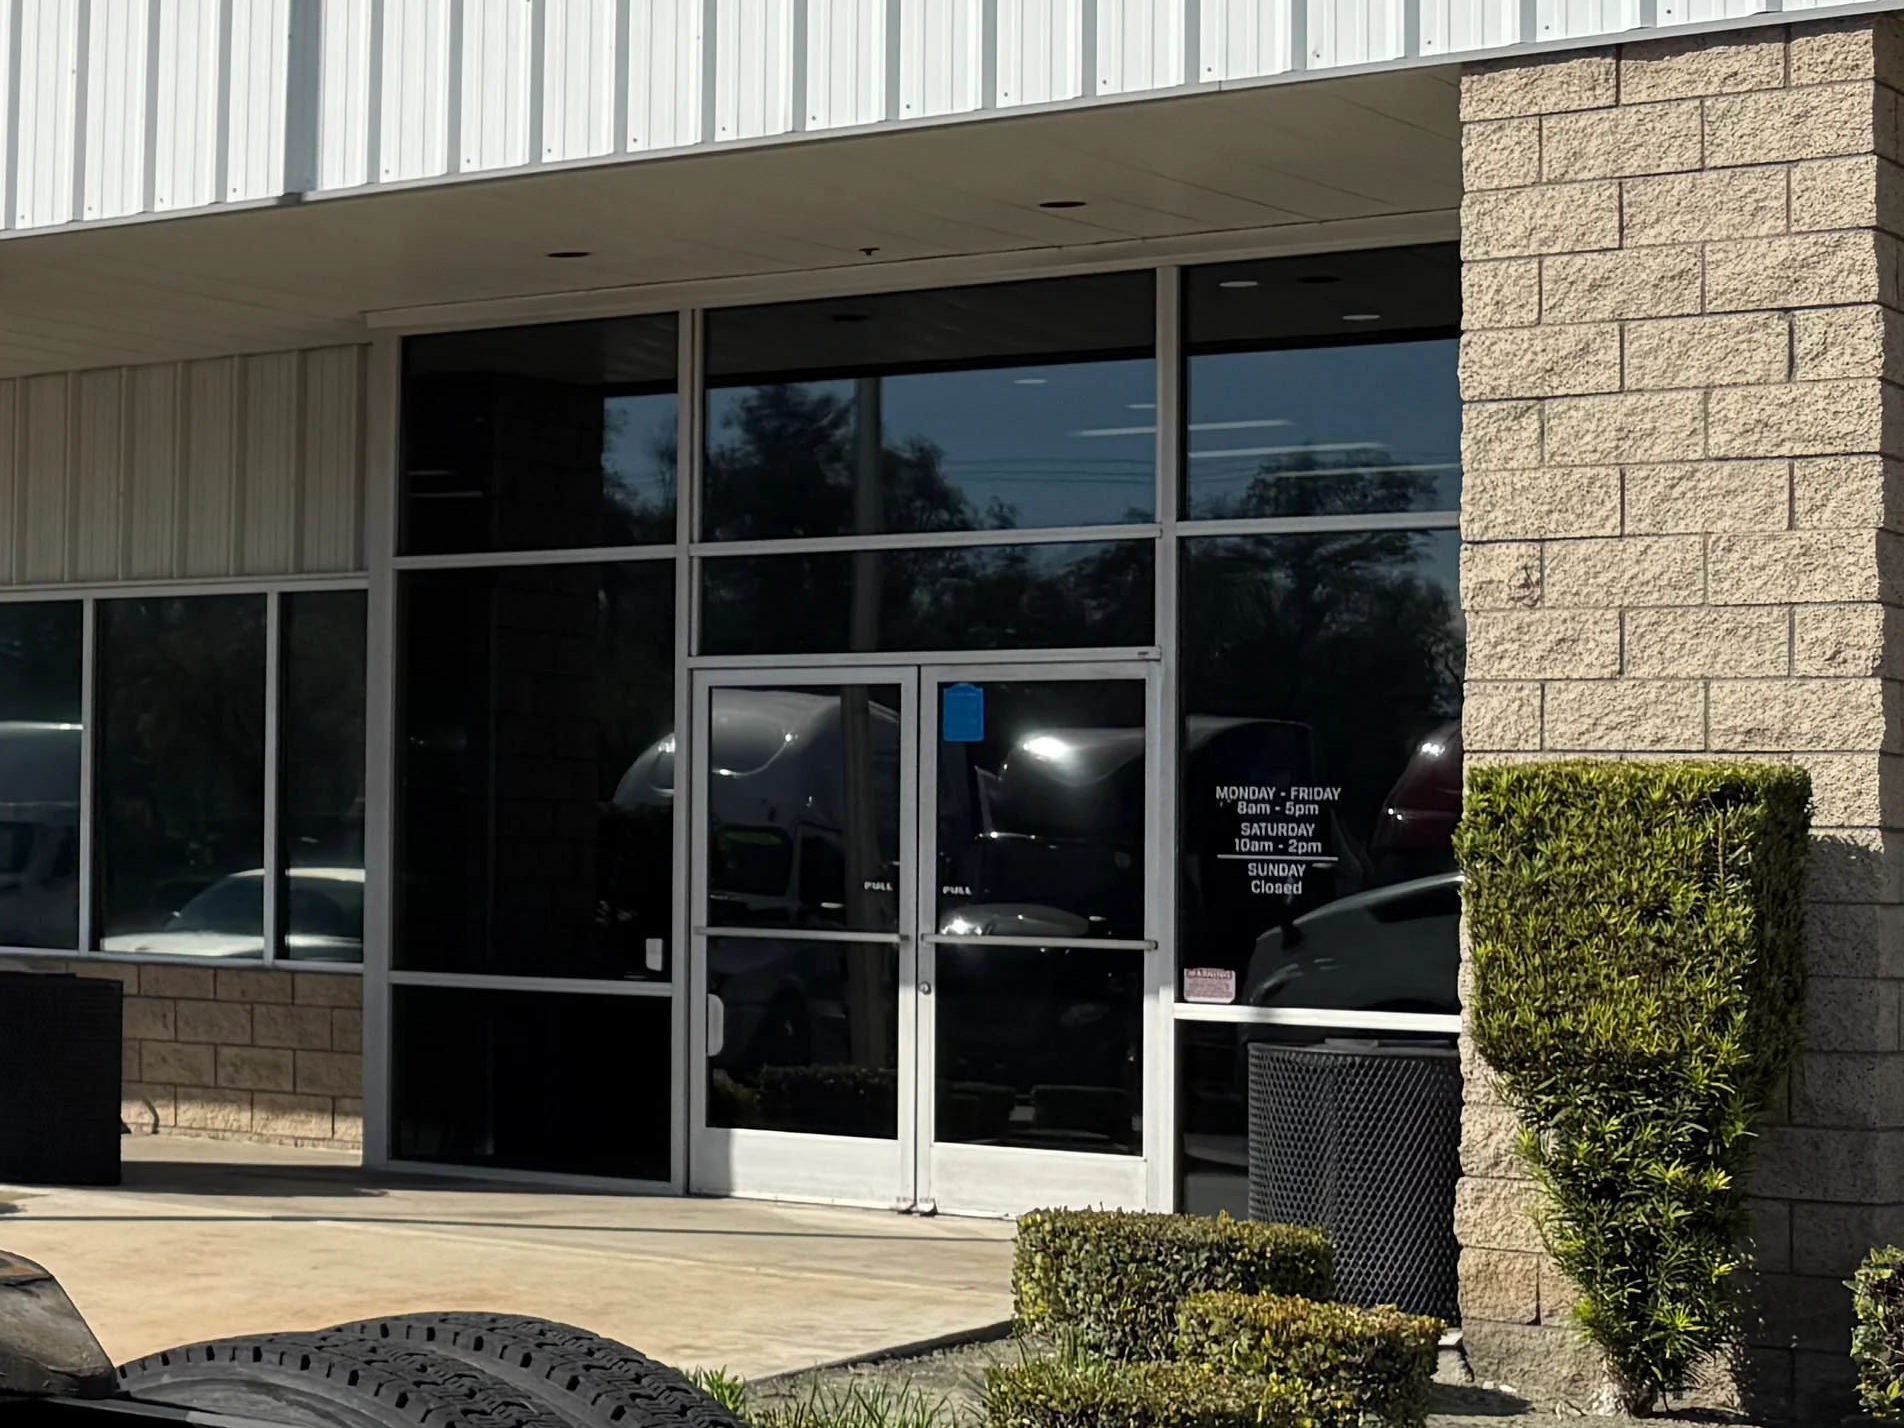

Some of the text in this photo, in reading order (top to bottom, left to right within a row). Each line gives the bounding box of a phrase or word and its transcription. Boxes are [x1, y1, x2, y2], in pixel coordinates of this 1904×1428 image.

[1215, 785, 1276, 801] MONDAY
[1290, 786, 1342, 801] FRIDAY
[1237, 801, 1271, 815] 8am
[1285, 801, 1319, 817] 5pm
[1240, 822, 1315, 837] SATURDAY
[1234, 838, 1273, 852] 10am
[1288, 839, 1322, 855] 2pm
[1247, 862, 1306, 877] SUNDAY
[864, 880, 893, 891] PULL
[942, 885, 972, 895] PULL
[1251, 879, 1302, 894] Closed
